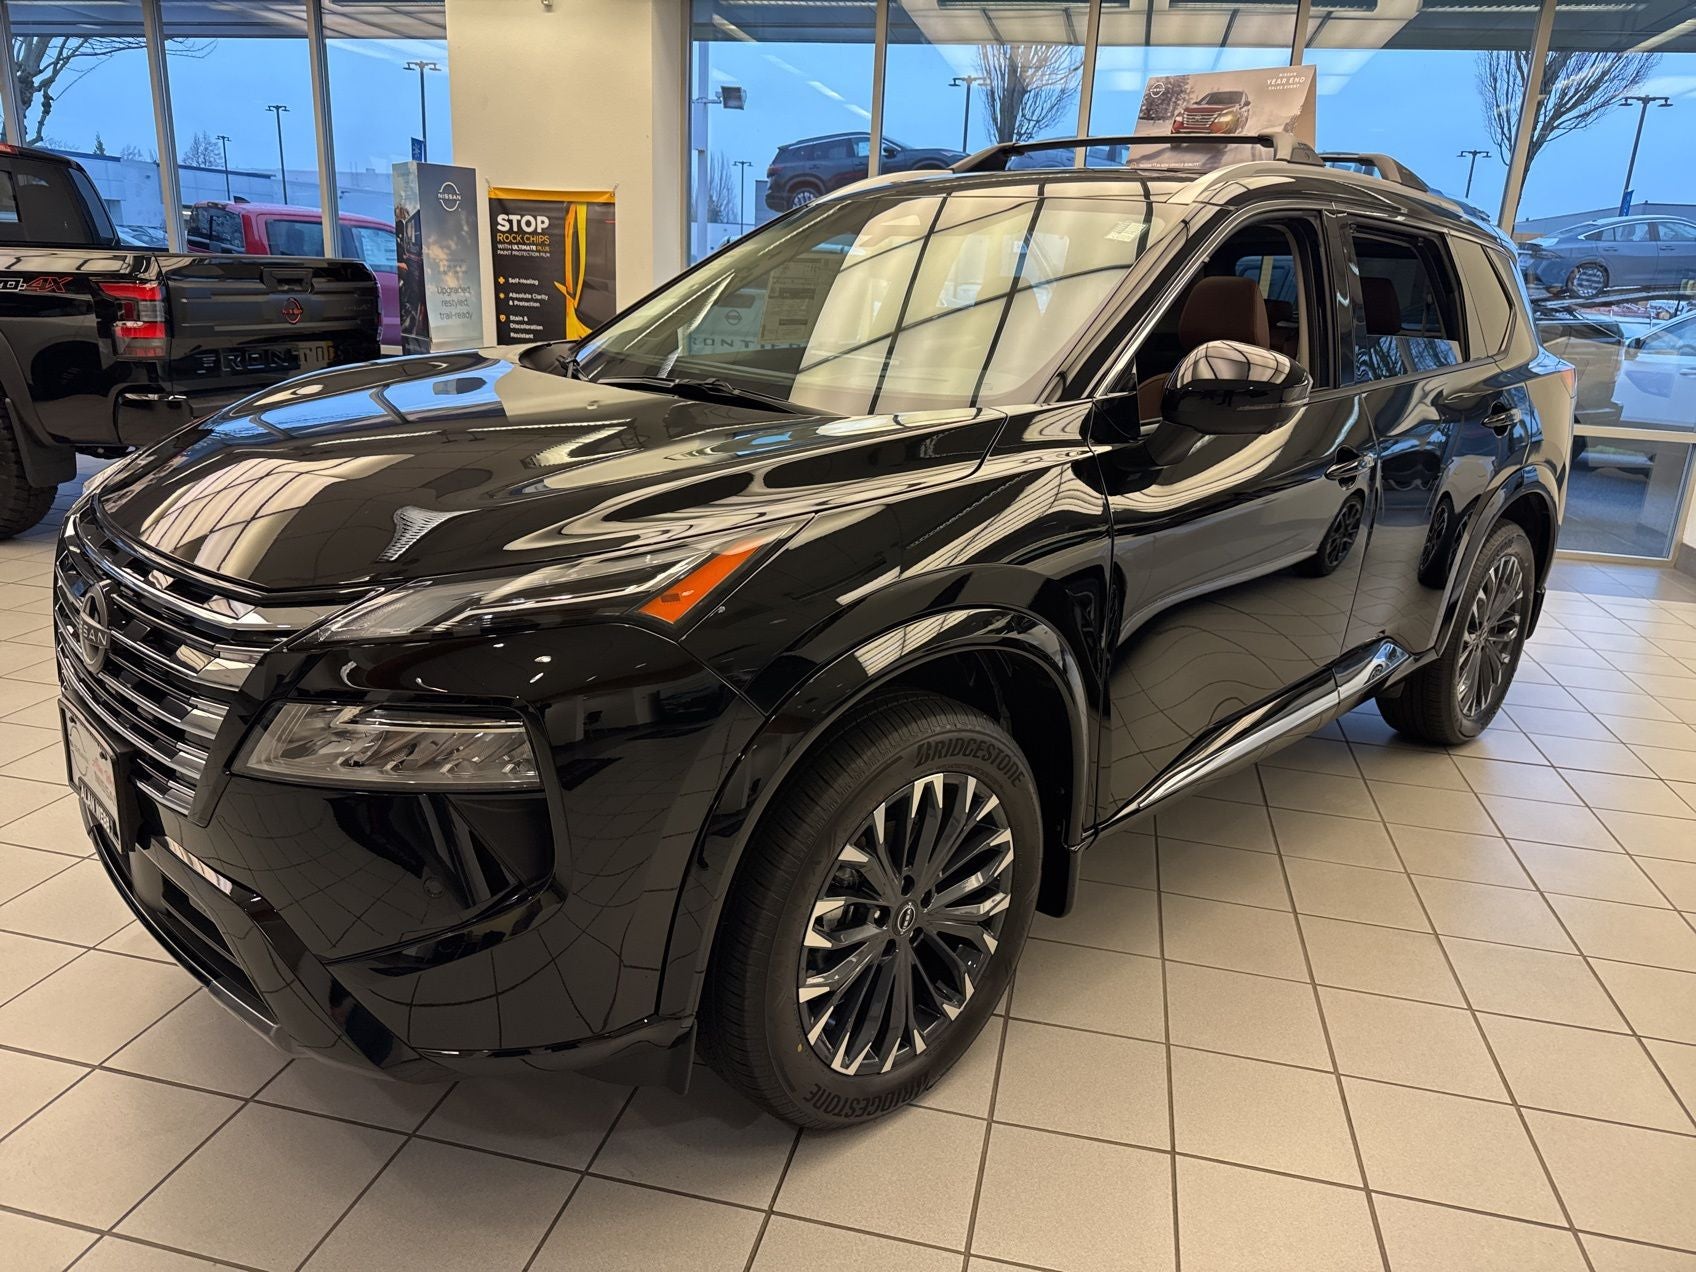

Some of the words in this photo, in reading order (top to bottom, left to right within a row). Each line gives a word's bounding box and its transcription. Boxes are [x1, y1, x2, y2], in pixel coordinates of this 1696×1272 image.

[1289, 76, 1306, 84] END
[497, 214, 550, 233] STOP
[497, 233, 522, 243] ROCK
[523, 234, 550, 245] CHIPS
[509, 278, 539, 286] Self-Healing
[440, 311, 473, 321] trail-ready
[913, 737, 1026, 788] BRIDGESTONE
[803, 1072, 930, 1119] BRIDGESTONE
